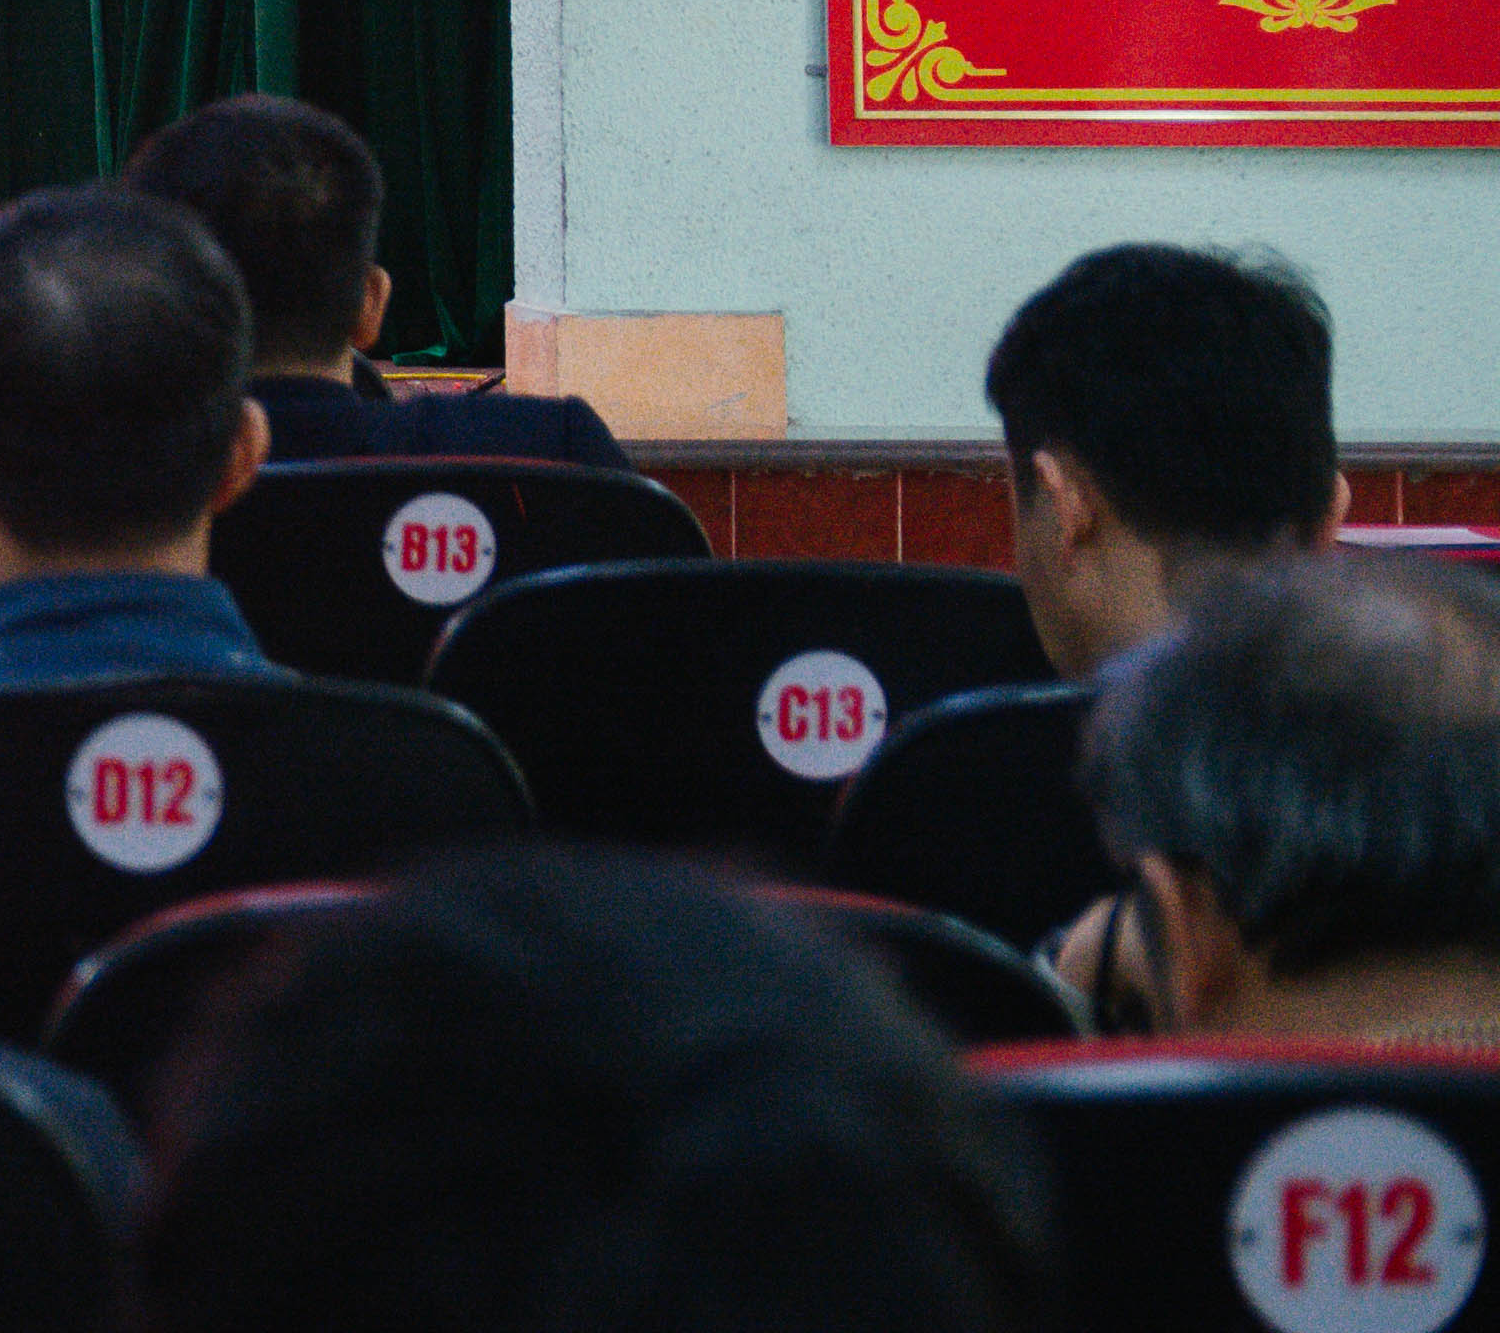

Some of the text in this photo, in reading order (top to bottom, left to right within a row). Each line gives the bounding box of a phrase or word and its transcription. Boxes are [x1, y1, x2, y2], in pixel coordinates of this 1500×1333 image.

[401, 523, 478, 573] B13
[777, 685, 864, 742] C13
[93, 757, 195, 826] D12
[1280, 1180, 1433, 1286] F12
